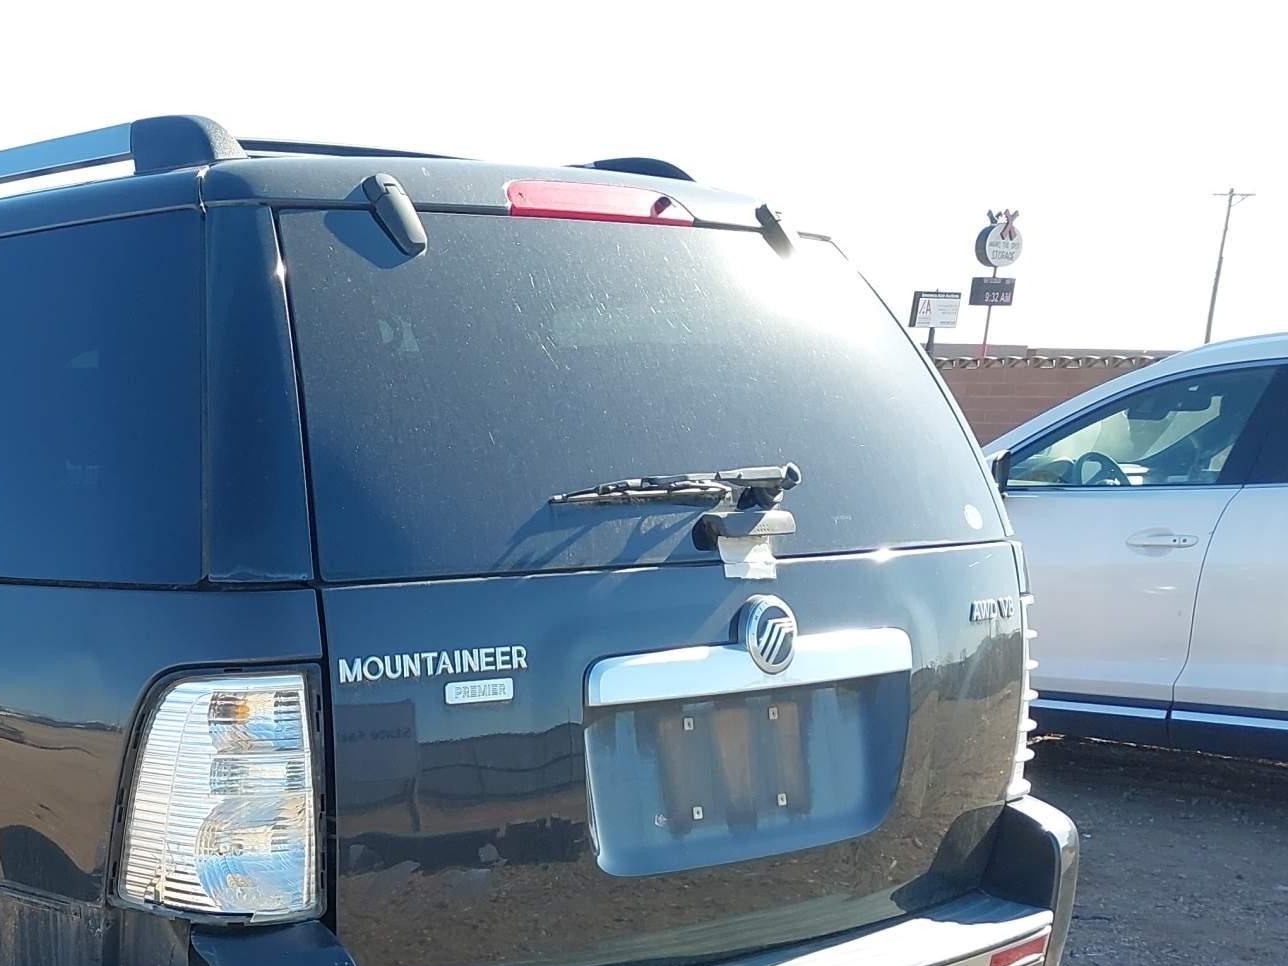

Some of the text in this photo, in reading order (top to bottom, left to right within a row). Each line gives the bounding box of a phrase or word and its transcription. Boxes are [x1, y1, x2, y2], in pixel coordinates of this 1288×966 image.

[991, 250, 1015, 261] STORAGE
[984, 291, 1012, 303] 9:32 AM
[970, 598, 998, 622] AWD
[338, 645, 528, 683] MOUNTAINEER
[454, 683, 507, 699] PREMIER
